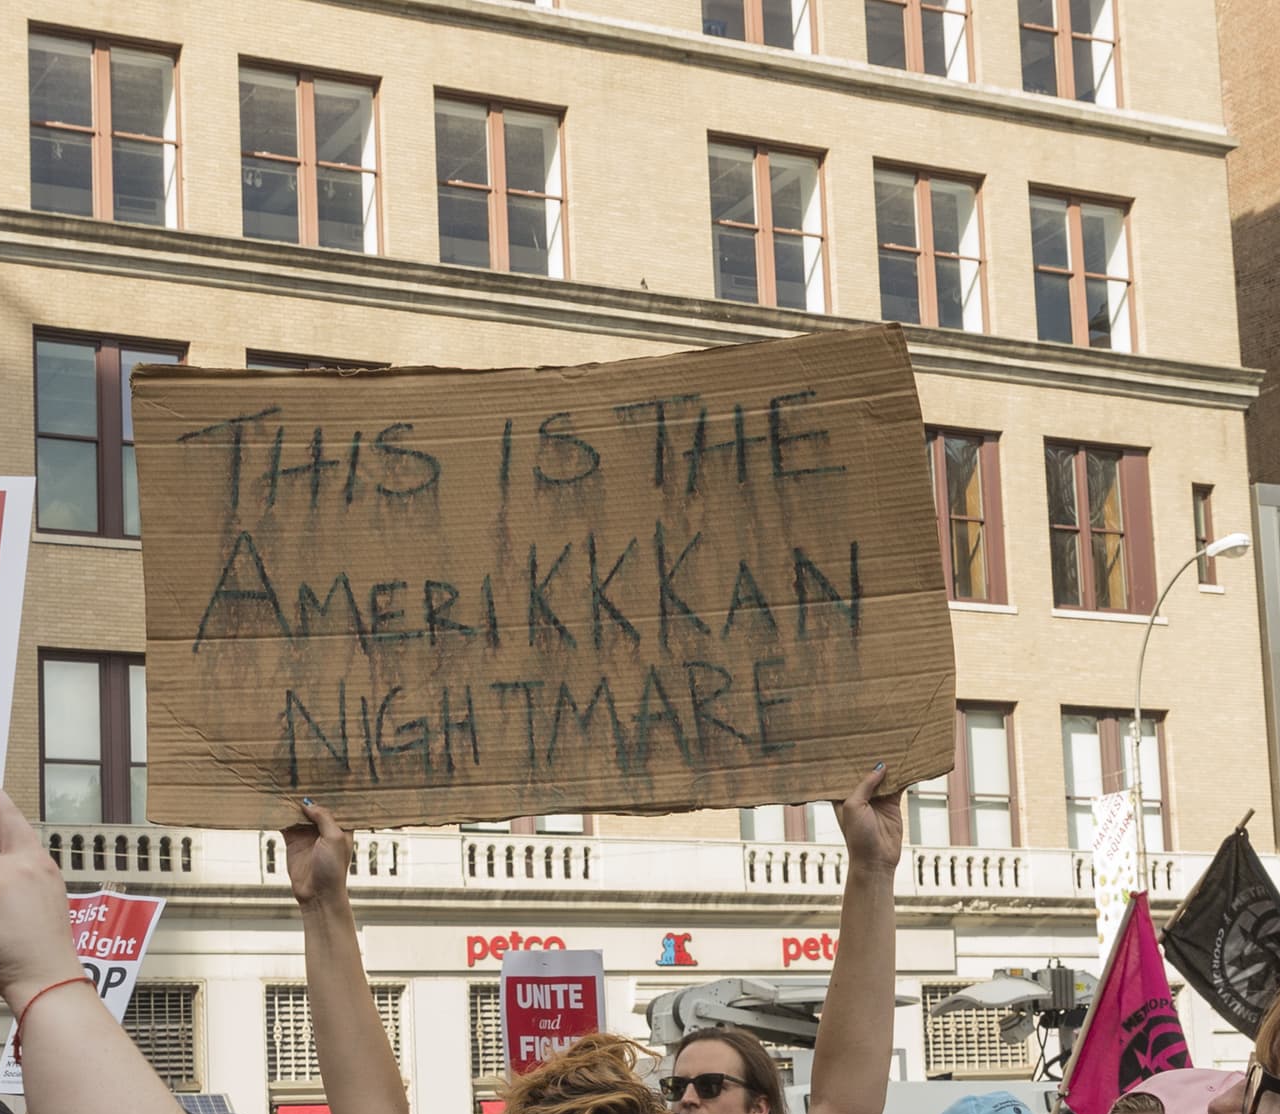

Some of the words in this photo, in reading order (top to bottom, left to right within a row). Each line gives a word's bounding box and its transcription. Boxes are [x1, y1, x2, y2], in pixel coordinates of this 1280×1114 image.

[176, 405, 441, 510] THIS
[499, 411, 601, 490] IS
[614, 389, 847, 492] THE
[192, 520, 863, 655] AMERIKKKAN
[281, 656, 796, 788] NIGHTMARE
[1107, 811, 1133, 860] SQUAR
[1231, 885, 1271, 911] METR
[70, 903, 109, 924] esist
[77, 931, 137, 957] Right
[783, 933, 839, 967] pet
[81, 963, 128, 999] OP
[516, 983, 584, 1010] UNITE
[539, 1014, 562, 1030] and
[520, 1036, 584, 1063] FIGH
